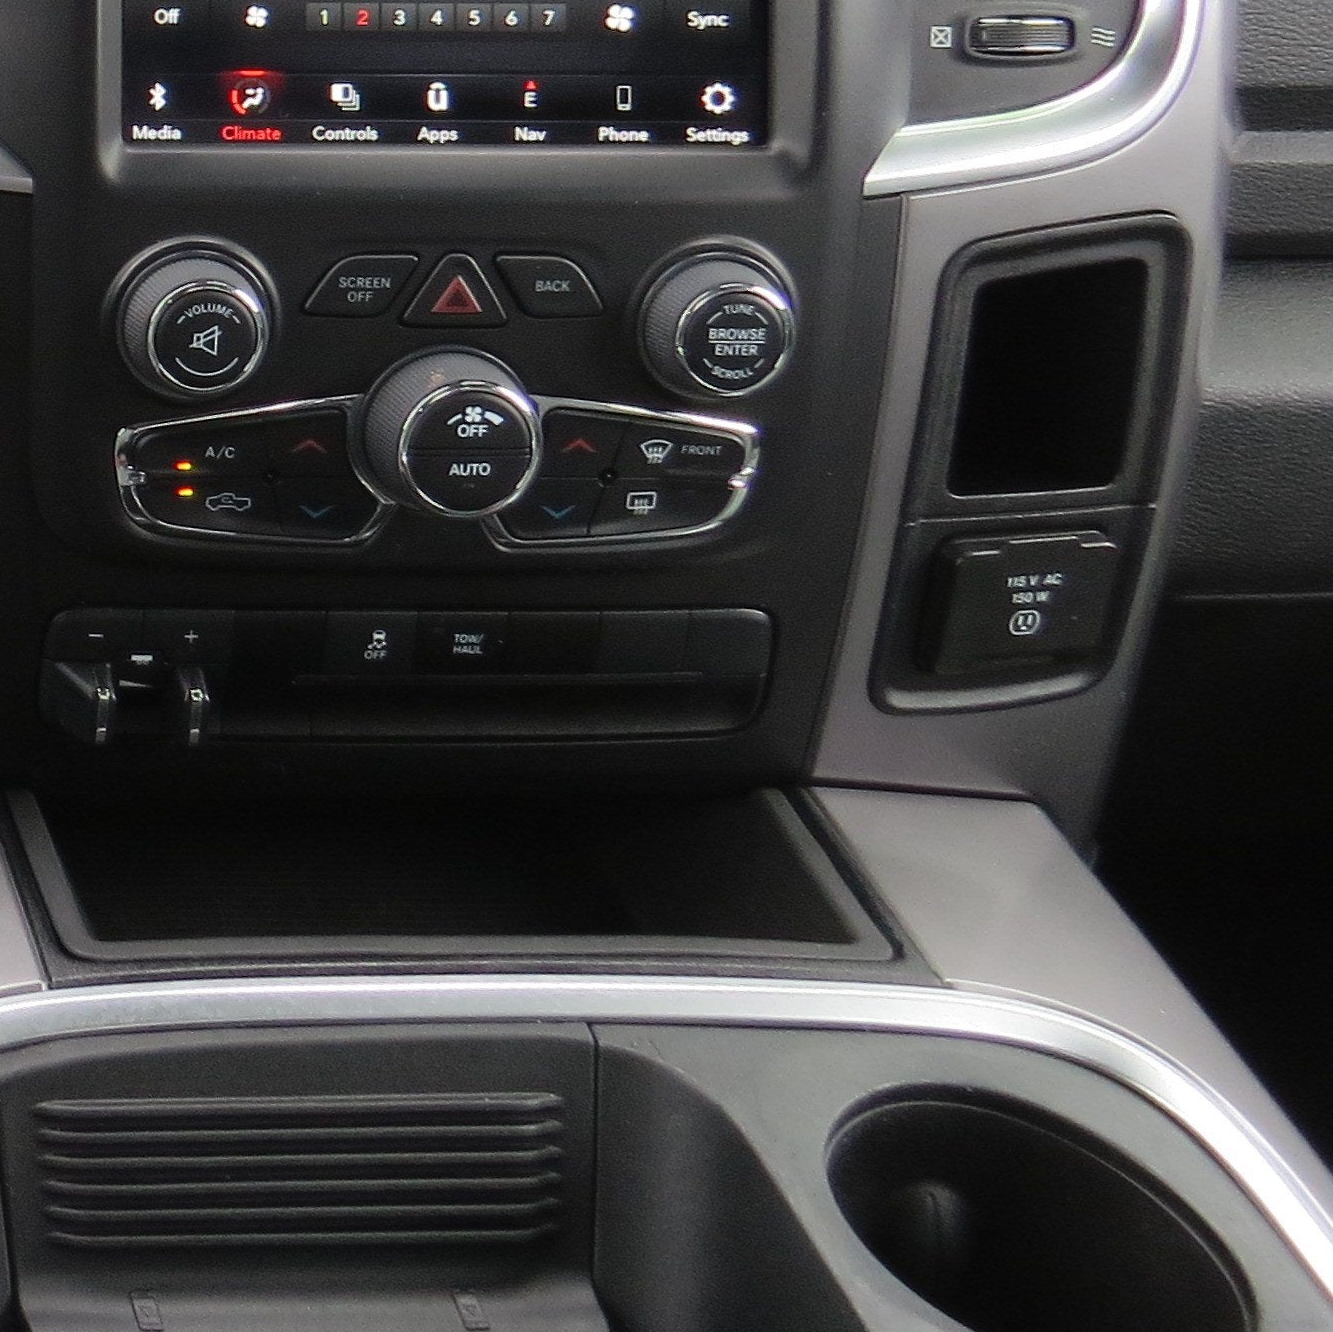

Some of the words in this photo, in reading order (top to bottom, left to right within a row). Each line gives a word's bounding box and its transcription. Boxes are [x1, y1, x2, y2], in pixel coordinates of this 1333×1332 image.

[154, 9, 180, 25] Off
[320, 11, 328, 26] 1
[357, 11, 368, 26] 2
[393, 11, 405, 26] 3
[430, 11, 442, 26] 4
[468, 11, 480, 26] 5
[505, 11, 517, 26] 6
[543, 11, 554, 26] 7
[687, 12, 728, 30] Sync
[133, 126, 181, 141] Media
[222, 125, 281, 141] Climate
[312, 125, 377, 141] Controls
[418, 126, 457, 145] Apps
[515, 127, 545, 141] Nav
[598, 126, 648, 141] Phone
[686, 127, 748, 145] Settings
[339, 276, 390, 289] SCREEN
[535, 280, 570, 292] BACK
[347, 290, 373, 302] OFF
[184, 304, 234, 321] VOLUME
[723, 304, 756, 316] TUNE
[709, 328, 765, 341] BROWSE
[715, 343, 757, 356] ENTER
[712, 364, 753, 379] SCROLL
[457, 423, 488, 438] OFF
[205, 445, 234, 459] A/C
[681, 444, 721, 456] FRONT
[448, 462, 491, 476] AUTO
[1007, 576, 1027, 587] 115
[1029, 575, 1040, 586] V
[1042, 573, 1062, 585] AC
[1012, 592, 1033, 603] 150
[1036, 591, 1050, 602] W
[453, 633, 483, 646] TOW/
[365, 649, 387, 659] OFF
[453, 643, 482, 655] HAUL
